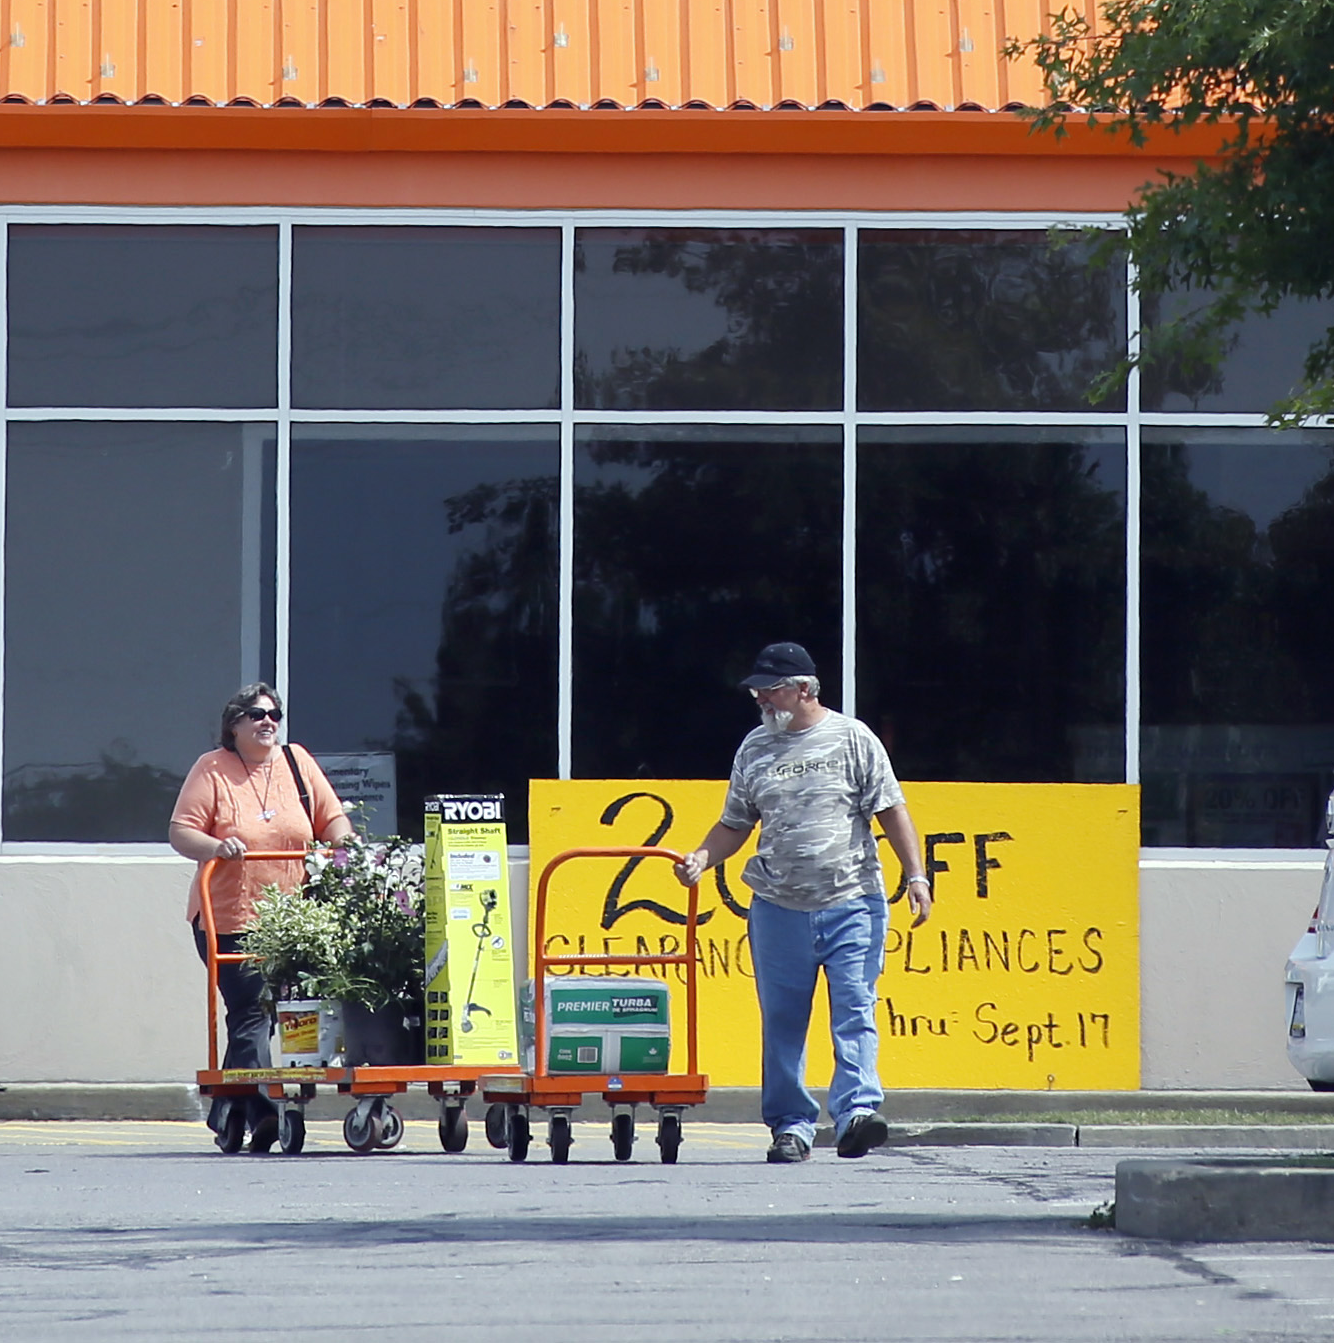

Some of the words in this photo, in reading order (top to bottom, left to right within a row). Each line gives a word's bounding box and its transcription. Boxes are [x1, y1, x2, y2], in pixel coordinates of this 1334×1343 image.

[362, 778, 391, 790] Wipes
[443, 801, 501, 820] RYOBI
[447, 827, 478, 836] Straight
[557, 1001, 610, 1012] PREMIER
[612, 998, 652, 1007] TURBA
[1078, 1012, 1109, 1049] 17
